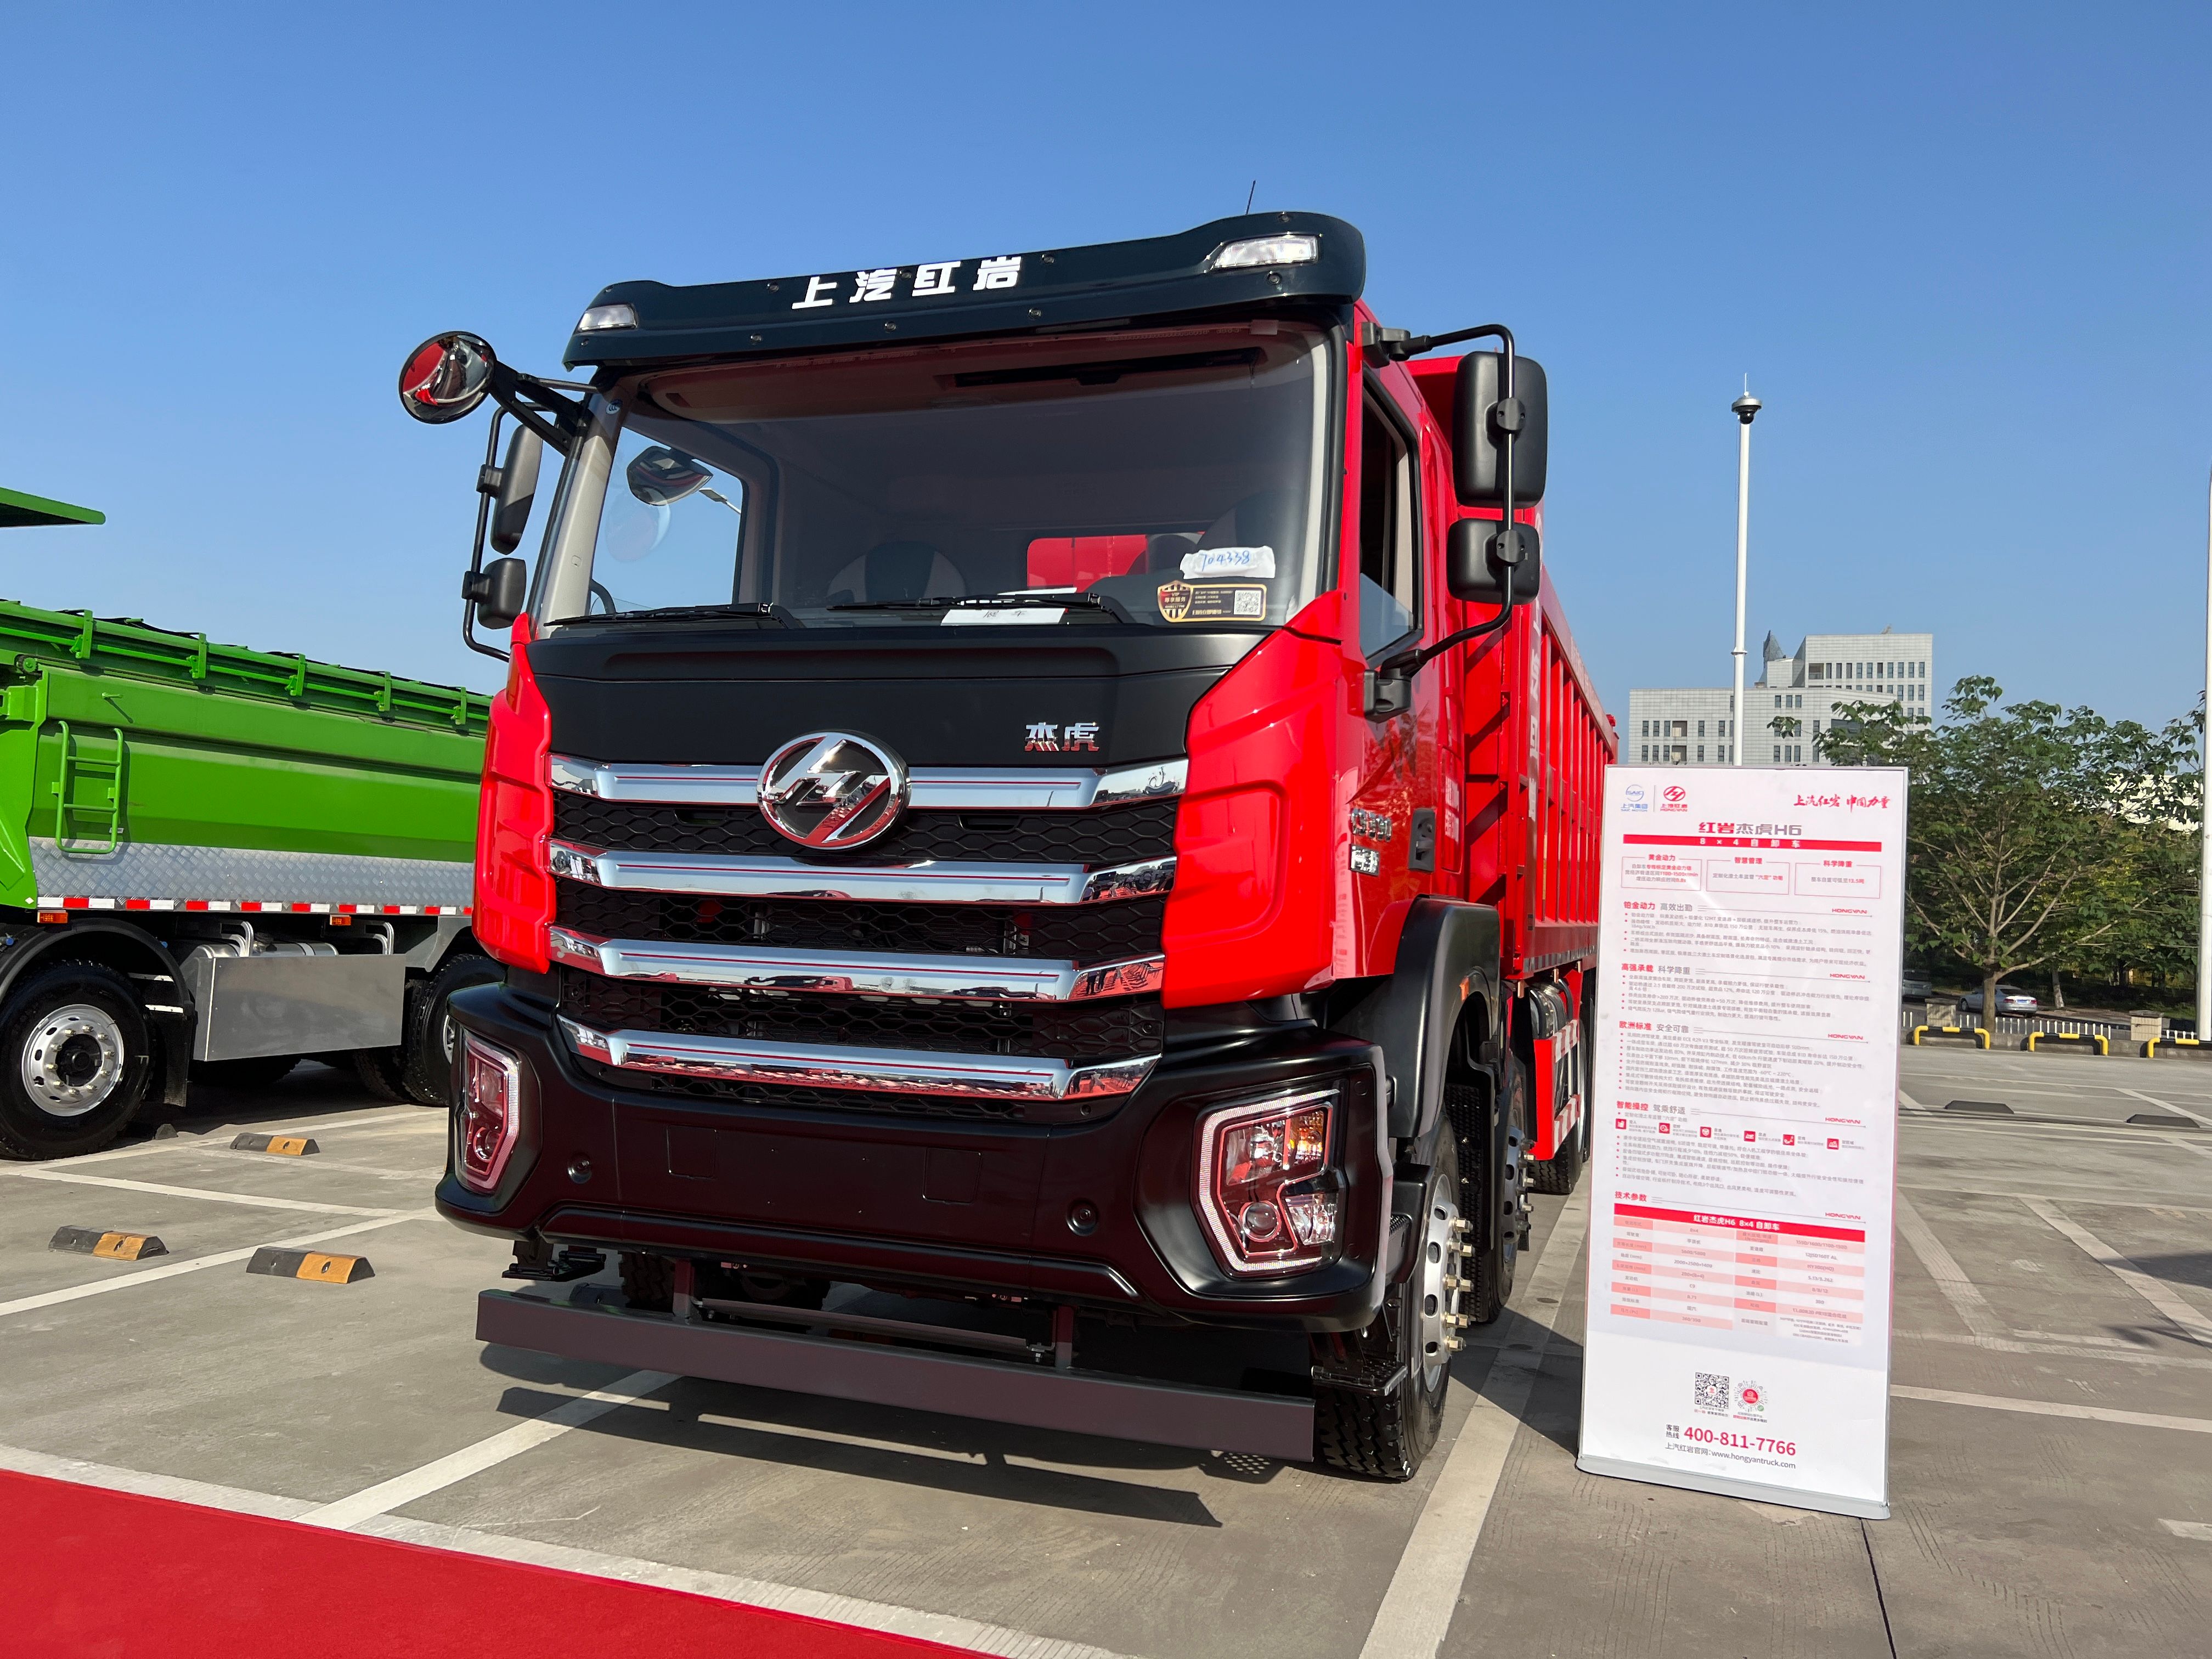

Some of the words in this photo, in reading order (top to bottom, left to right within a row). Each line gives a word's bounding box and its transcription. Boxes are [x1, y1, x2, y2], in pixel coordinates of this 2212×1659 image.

[791, 256, 1022, 309] 上汽红岩
[1199, 550, 1250, 572] 704338
[1024, 722, 1100, 752] 杰虎
[1793, 794, 1841, 808] 上汽红岩
[1846, 794, 1891, 813] 中国力量
[1698, 822, 1802, 836] 红岩杰虎H6
[1623, 901, 1656, 910] 铂金动力
[1660, 903, 1693, 912] 高效出勤
[1621, 963, 1654, 972] 高强承载
[1658, 966, 1690, 975] 科学降重
[1619, 1021, 1652, 1031] 欧洲标准
[1656, 1024, 1689, 1033] 安全可靠
[1616, 1101, 1649, 1111] 智能操控
[1653, 1104, 1686, 1114] 驾乘舒适
[1615, 1191, 1647, 1202] 技术参数
[1693, 1214, 1736, 1226] 红岩杰虎H6
[1756, 1221, 1780, 1231] 自卸车
[1666, 1424, 1680, 1432] 客服
[1666, 1431, 1679, 1439] 热线
[1684, 1426, 1797, 1456] 400-811-7766
